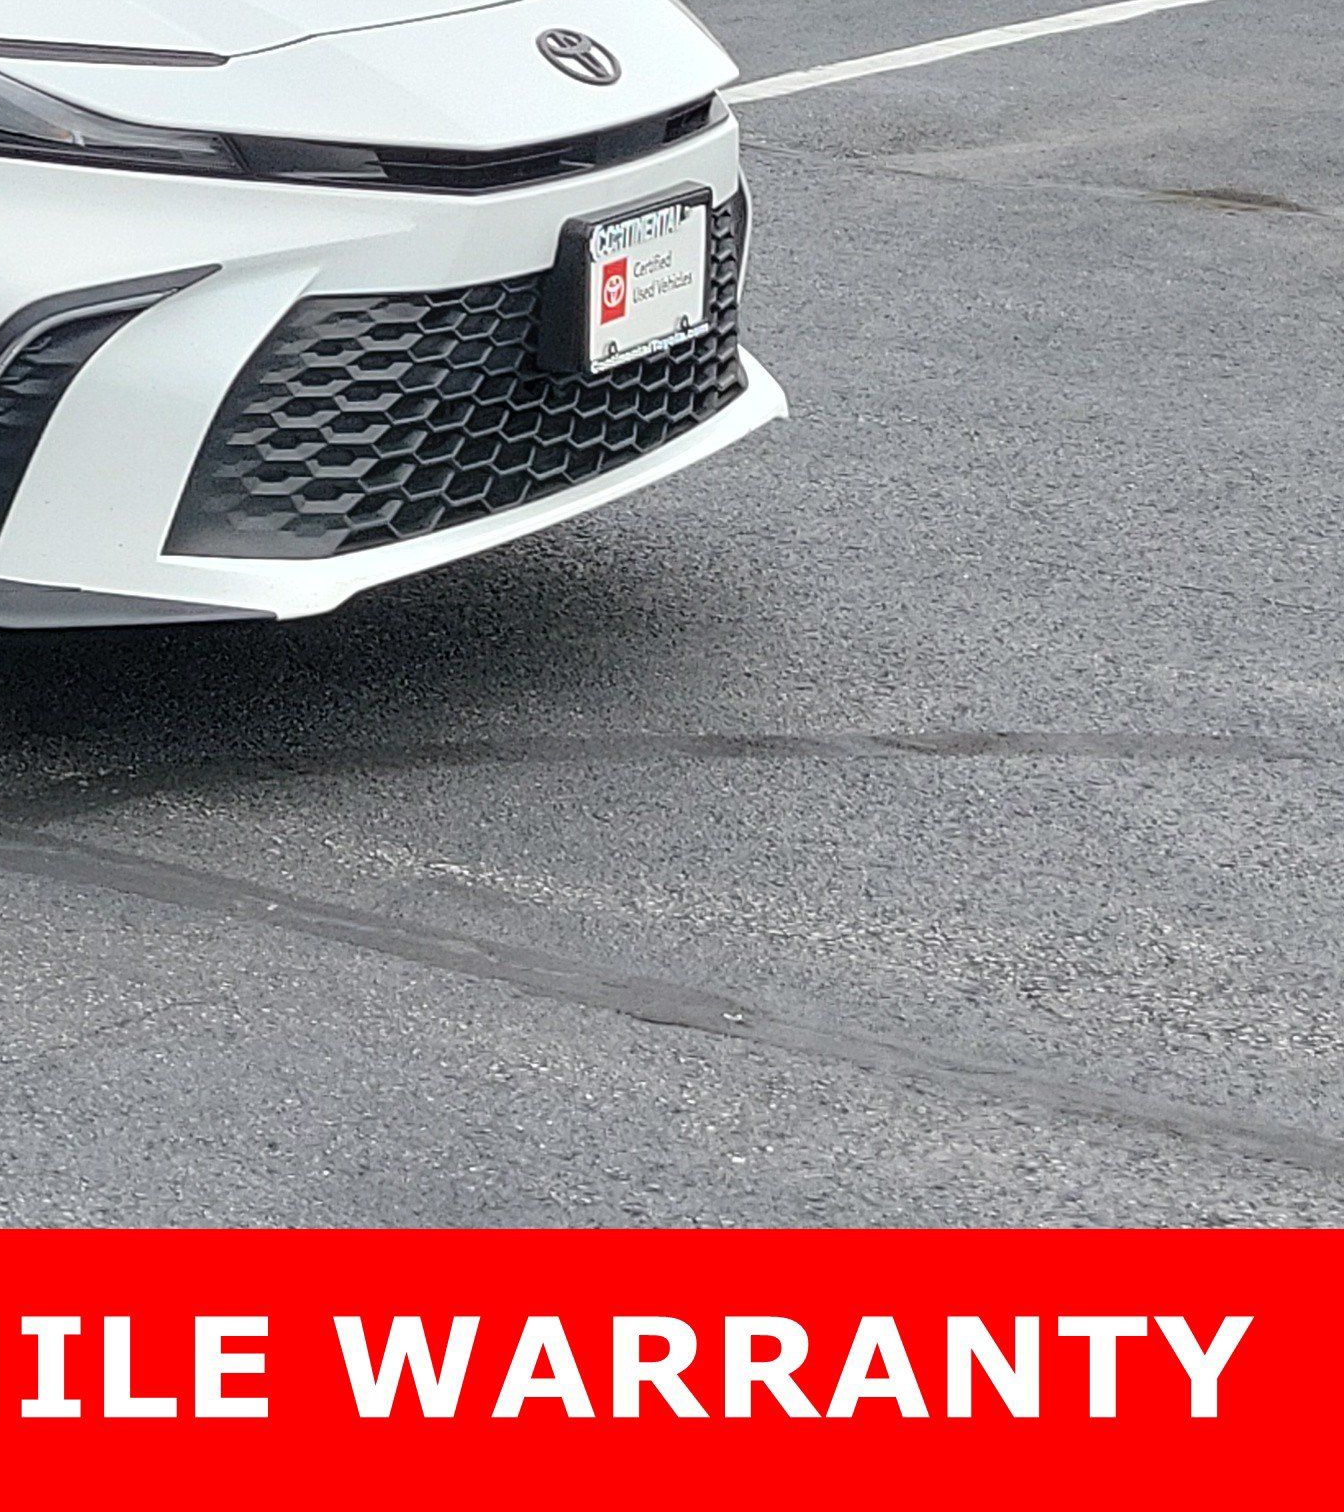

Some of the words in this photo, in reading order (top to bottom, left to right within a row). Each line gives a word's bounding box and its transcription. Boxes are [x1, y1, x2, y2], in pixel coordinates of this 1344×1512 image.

[633, 250, 672, 278] Certified
[633, 282, 655, 304] Used
[655, 272, 693, 294] Vehicles
